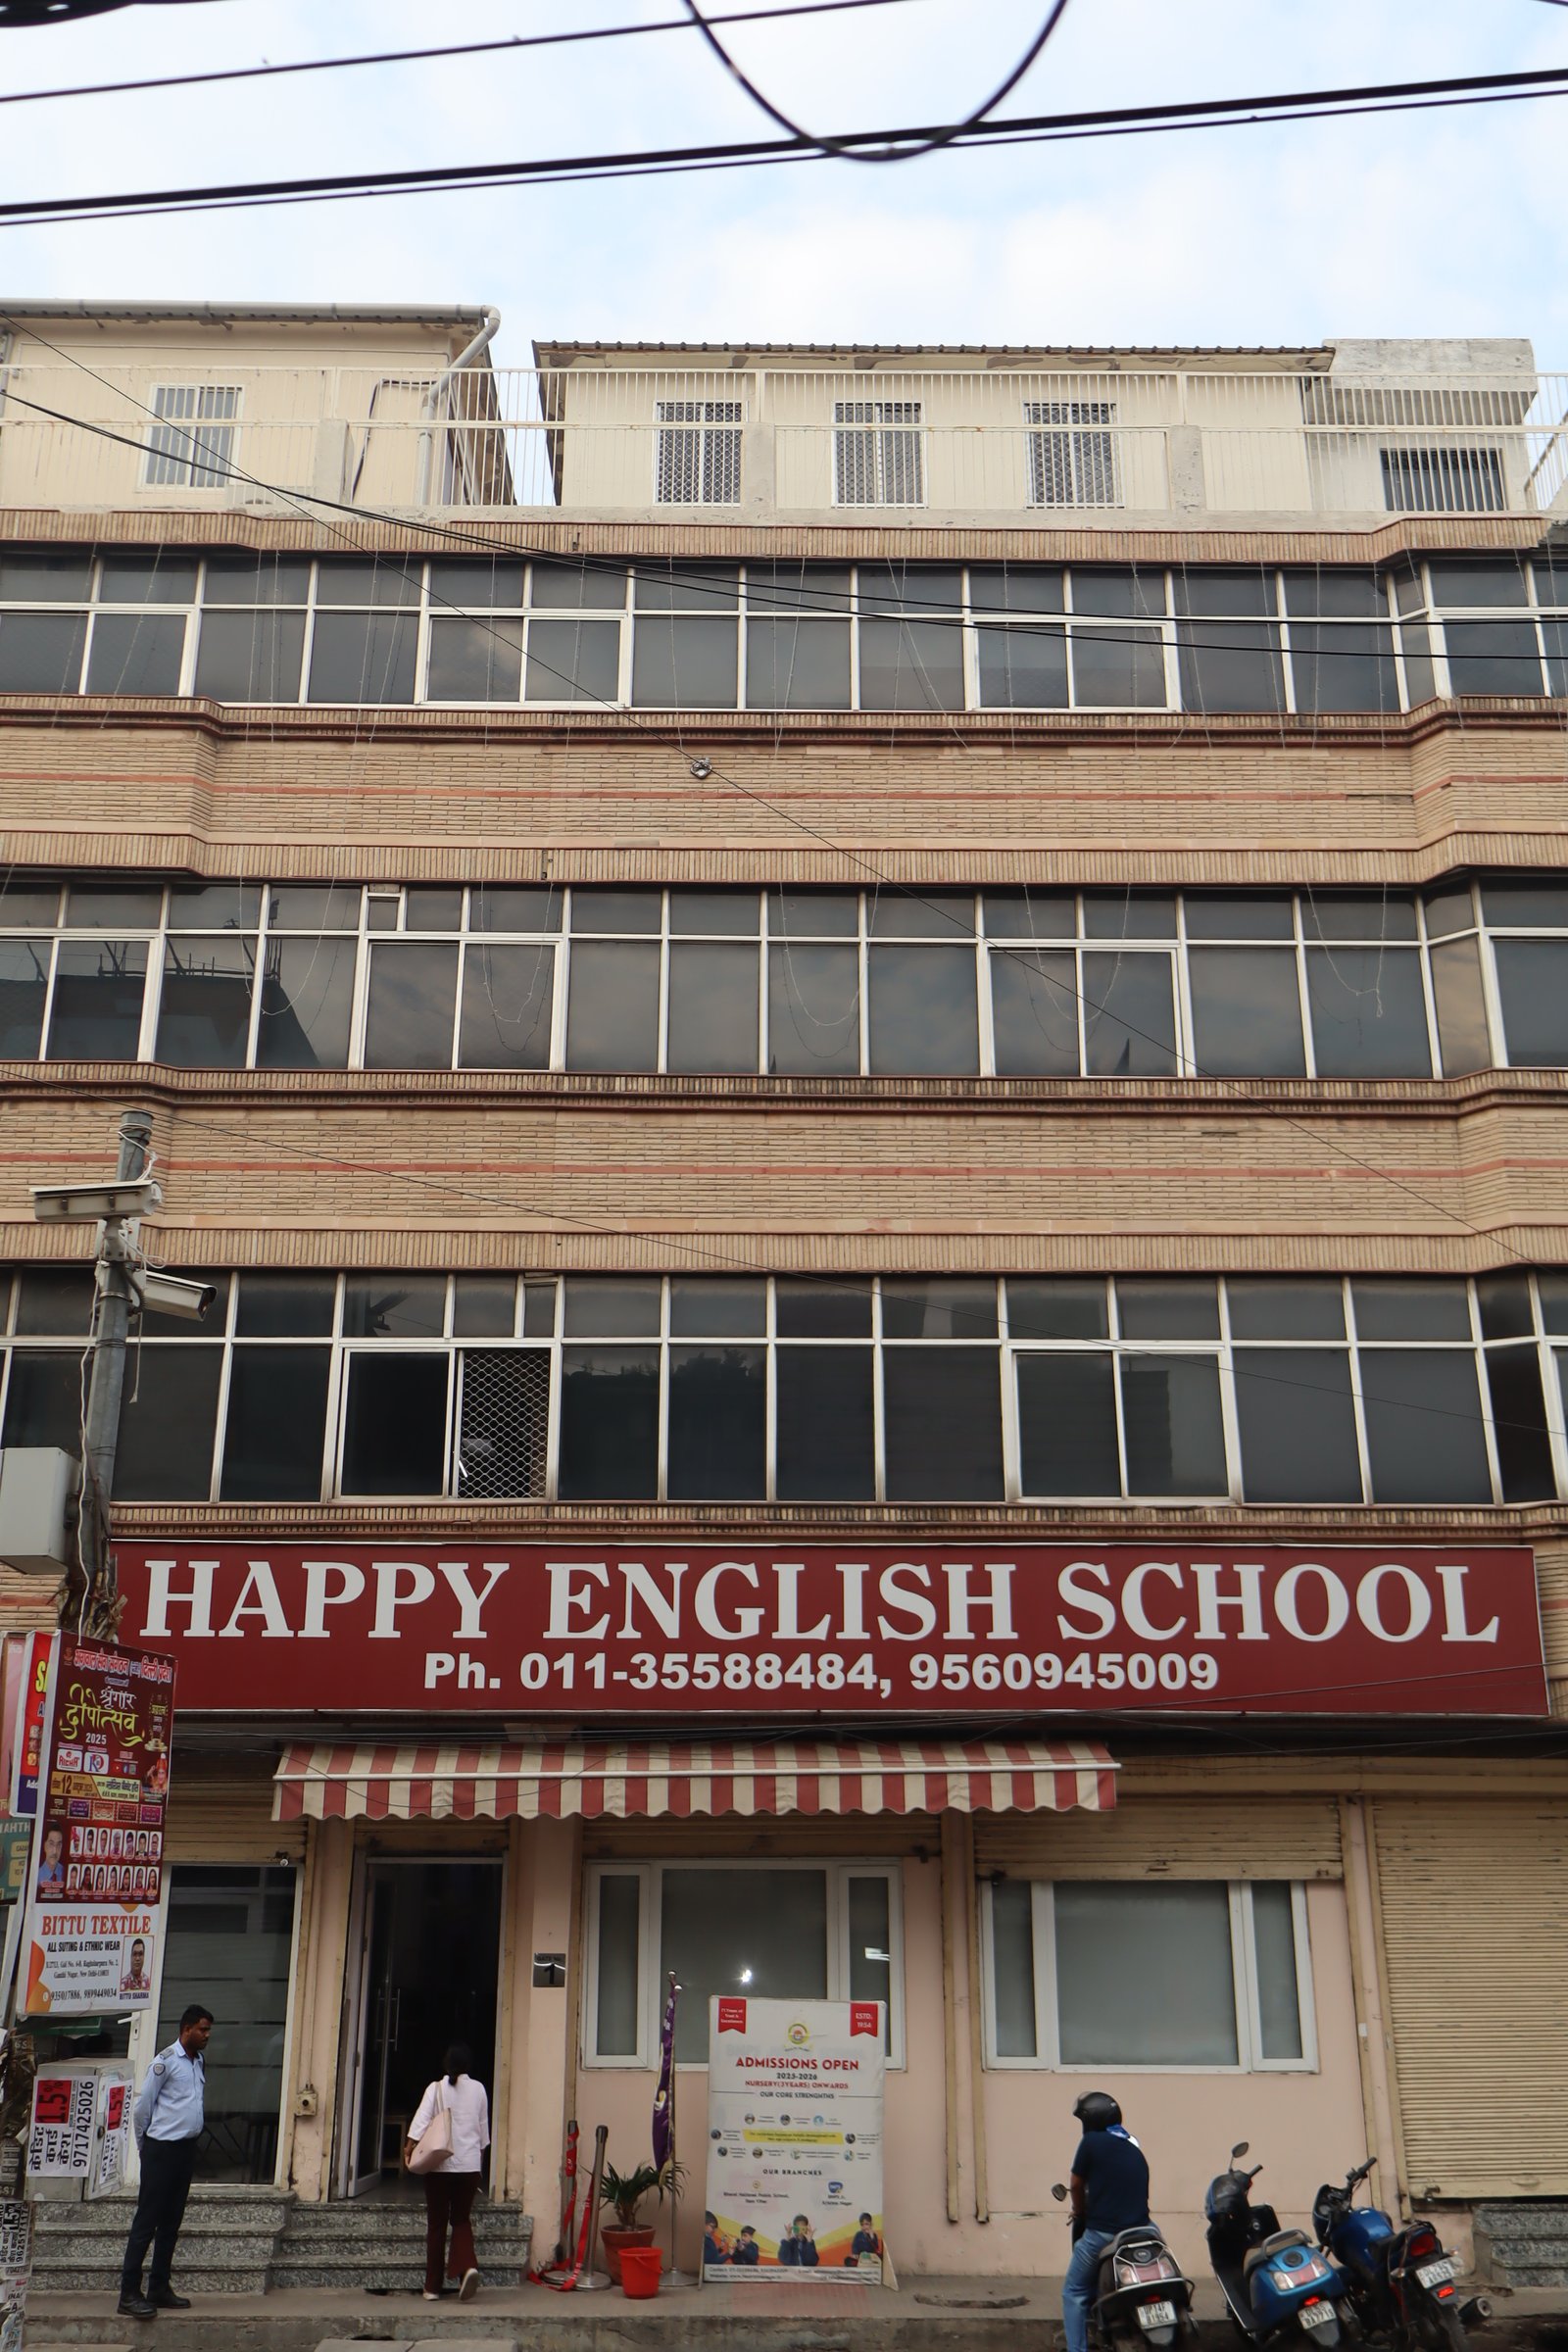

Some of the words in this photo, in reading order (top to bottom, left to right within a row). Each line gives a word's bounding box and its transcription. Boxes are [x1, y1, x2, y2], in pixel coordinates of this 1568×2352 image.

[139, 1560, 510, 1639] HAPPY
[543, 1563, 1018, 1641] ENGLISH
[1057, 1563, 1499, 1642] SCHOOL
[424, 1652, 501, 1690] Ph.
[520, 1652, 892, 1698] 011-35588484,
[909, 1653, 1218, 1690] 9560945009
[85, 1733, 107, 1745] 2025
[62, 1774, 72, 1794] 12
[41, 1915, 87, 1936] BITTU
[91, 1915, 151, 1935] TEXTILE
[47, 1942, 57, 1952] ALL
[84, 1941, 103, 1951] ETHNIC
[104, 1941, 121, 1951] WEAR
[544, 1963, 555, 1984] 1
[736, 2057, 817, 2070] ADMISSIONS
[822, 2059, 859, 2071] OPEN
[37, 2081, 68, 2124] 1.5%
[73, 2081, 94, 2168] 9717425026
[29, 2126, 44, 2171] क्रेडिट
[45, 2128, 58, 2163] कार्ड
